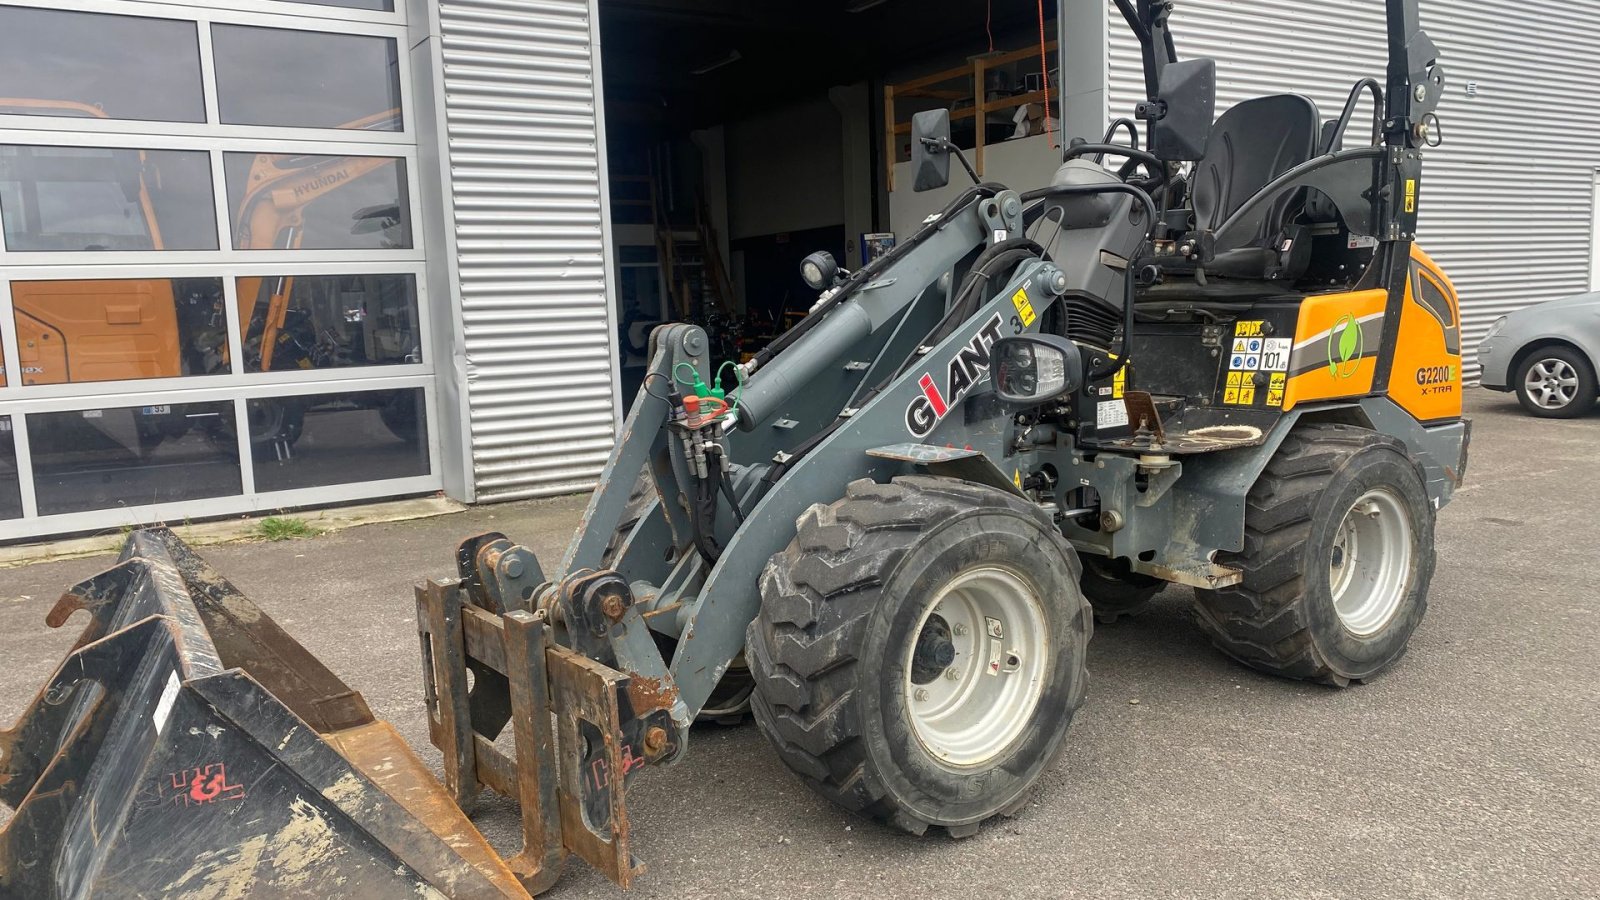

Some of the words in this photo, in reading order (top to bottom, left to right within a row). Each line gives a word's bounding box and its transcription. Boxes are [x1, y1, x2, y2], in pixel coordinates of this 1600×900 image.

[293, 169, 350, 198] HYUNDAI
[1009, 315, 1023, 335] 3
[1264, 352, 1280, 368] 101
[1416, 365, 1456, 385] G2200E
[1421, 385, 1452, 395] X-TRA
